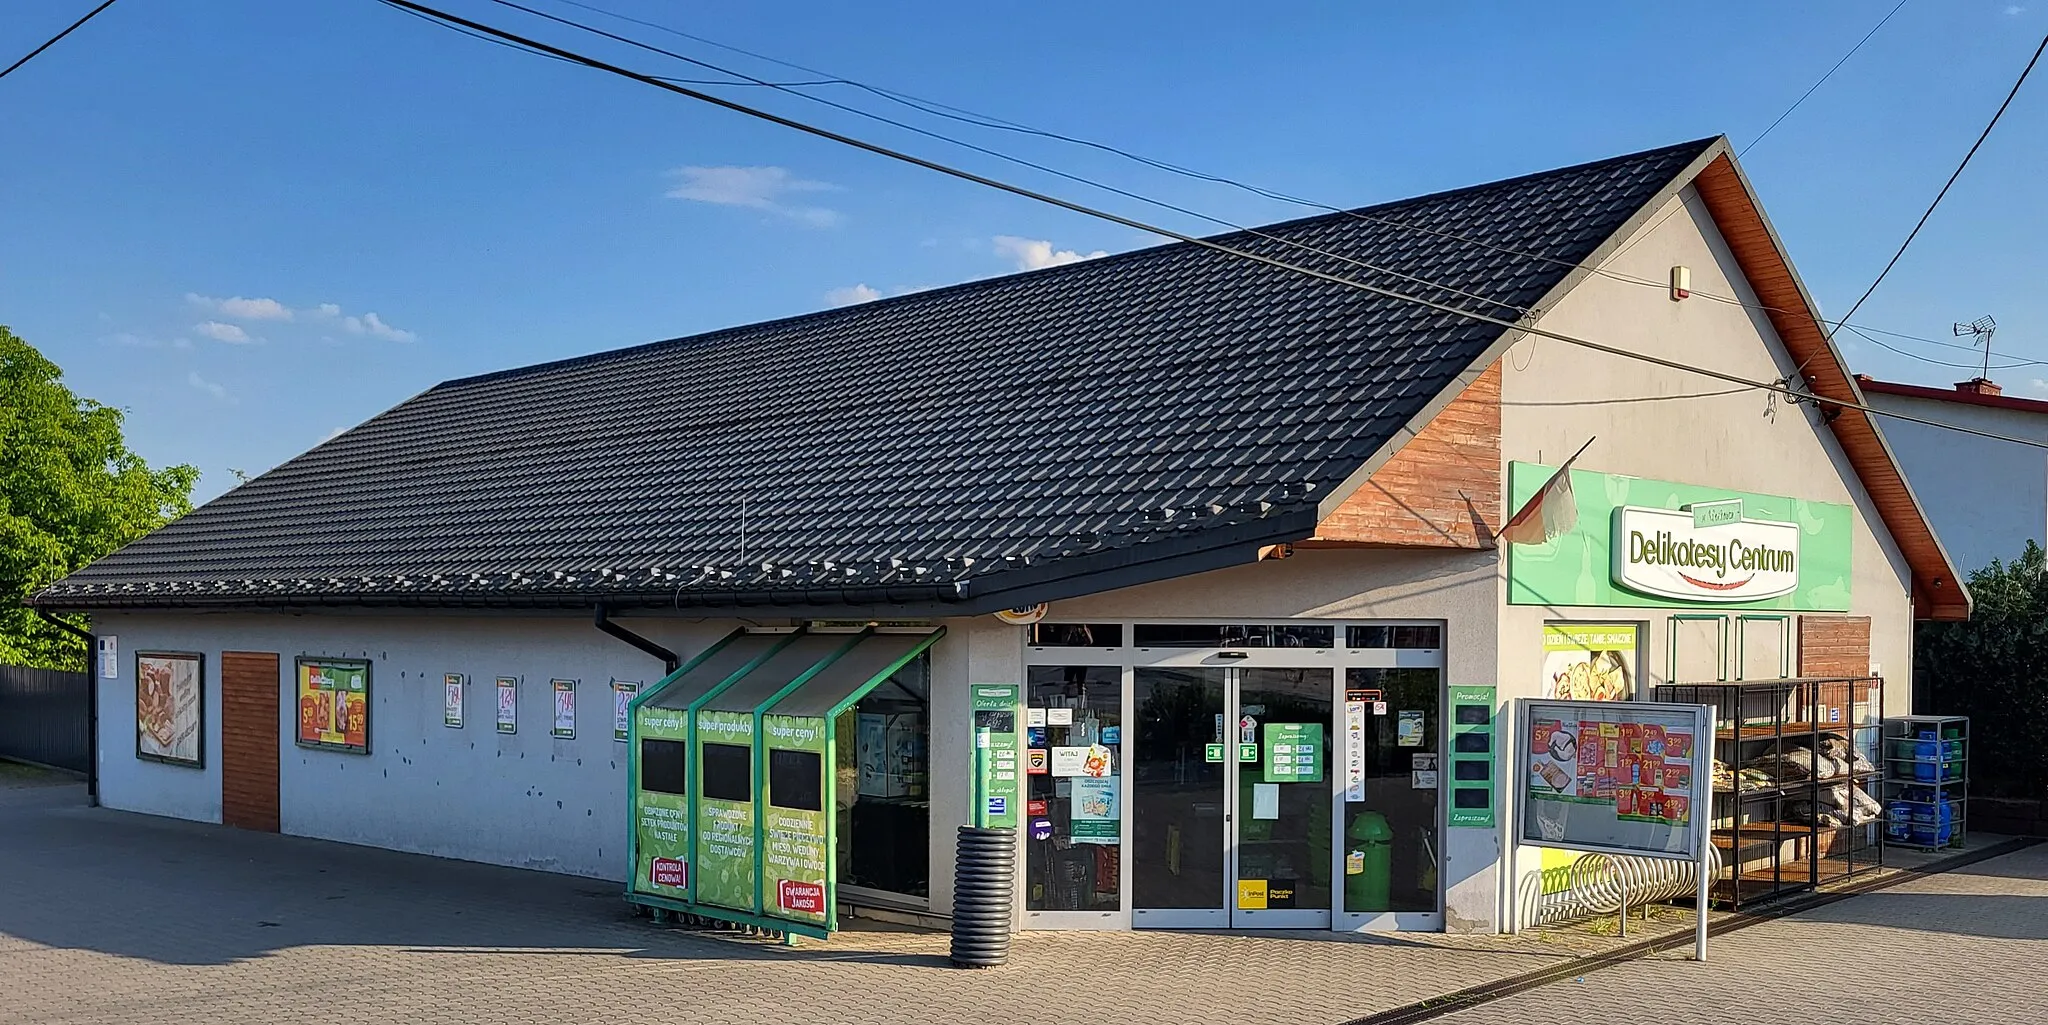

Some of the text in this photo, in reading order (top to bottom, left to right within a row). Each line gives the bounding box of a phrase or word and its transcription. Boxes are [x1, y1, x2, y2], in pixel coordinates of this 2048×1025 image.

[1630, 530, 1794, 578] Delikatesy Centrum
[1456, 691, 1489, 702] Promocja!
[644, 717, 662, 730] super
[698, 721, 718, 733] super
[772, 727, 794, 740] super
[795, 728, 815, 742] ceny
[708, 807, 747, 821] SPRAWDZONE
[778, 817, 814, 830] CODZIENNIE
[656, 862, 682, 872] KONTROLA
[768, 853, 800, 868] WARZYWA
[803, 860, 825, 872] OWOCE
[785, 885, 820, 897] GWARANCJA
[791, 897, 815, 909] JAKOŚCI
